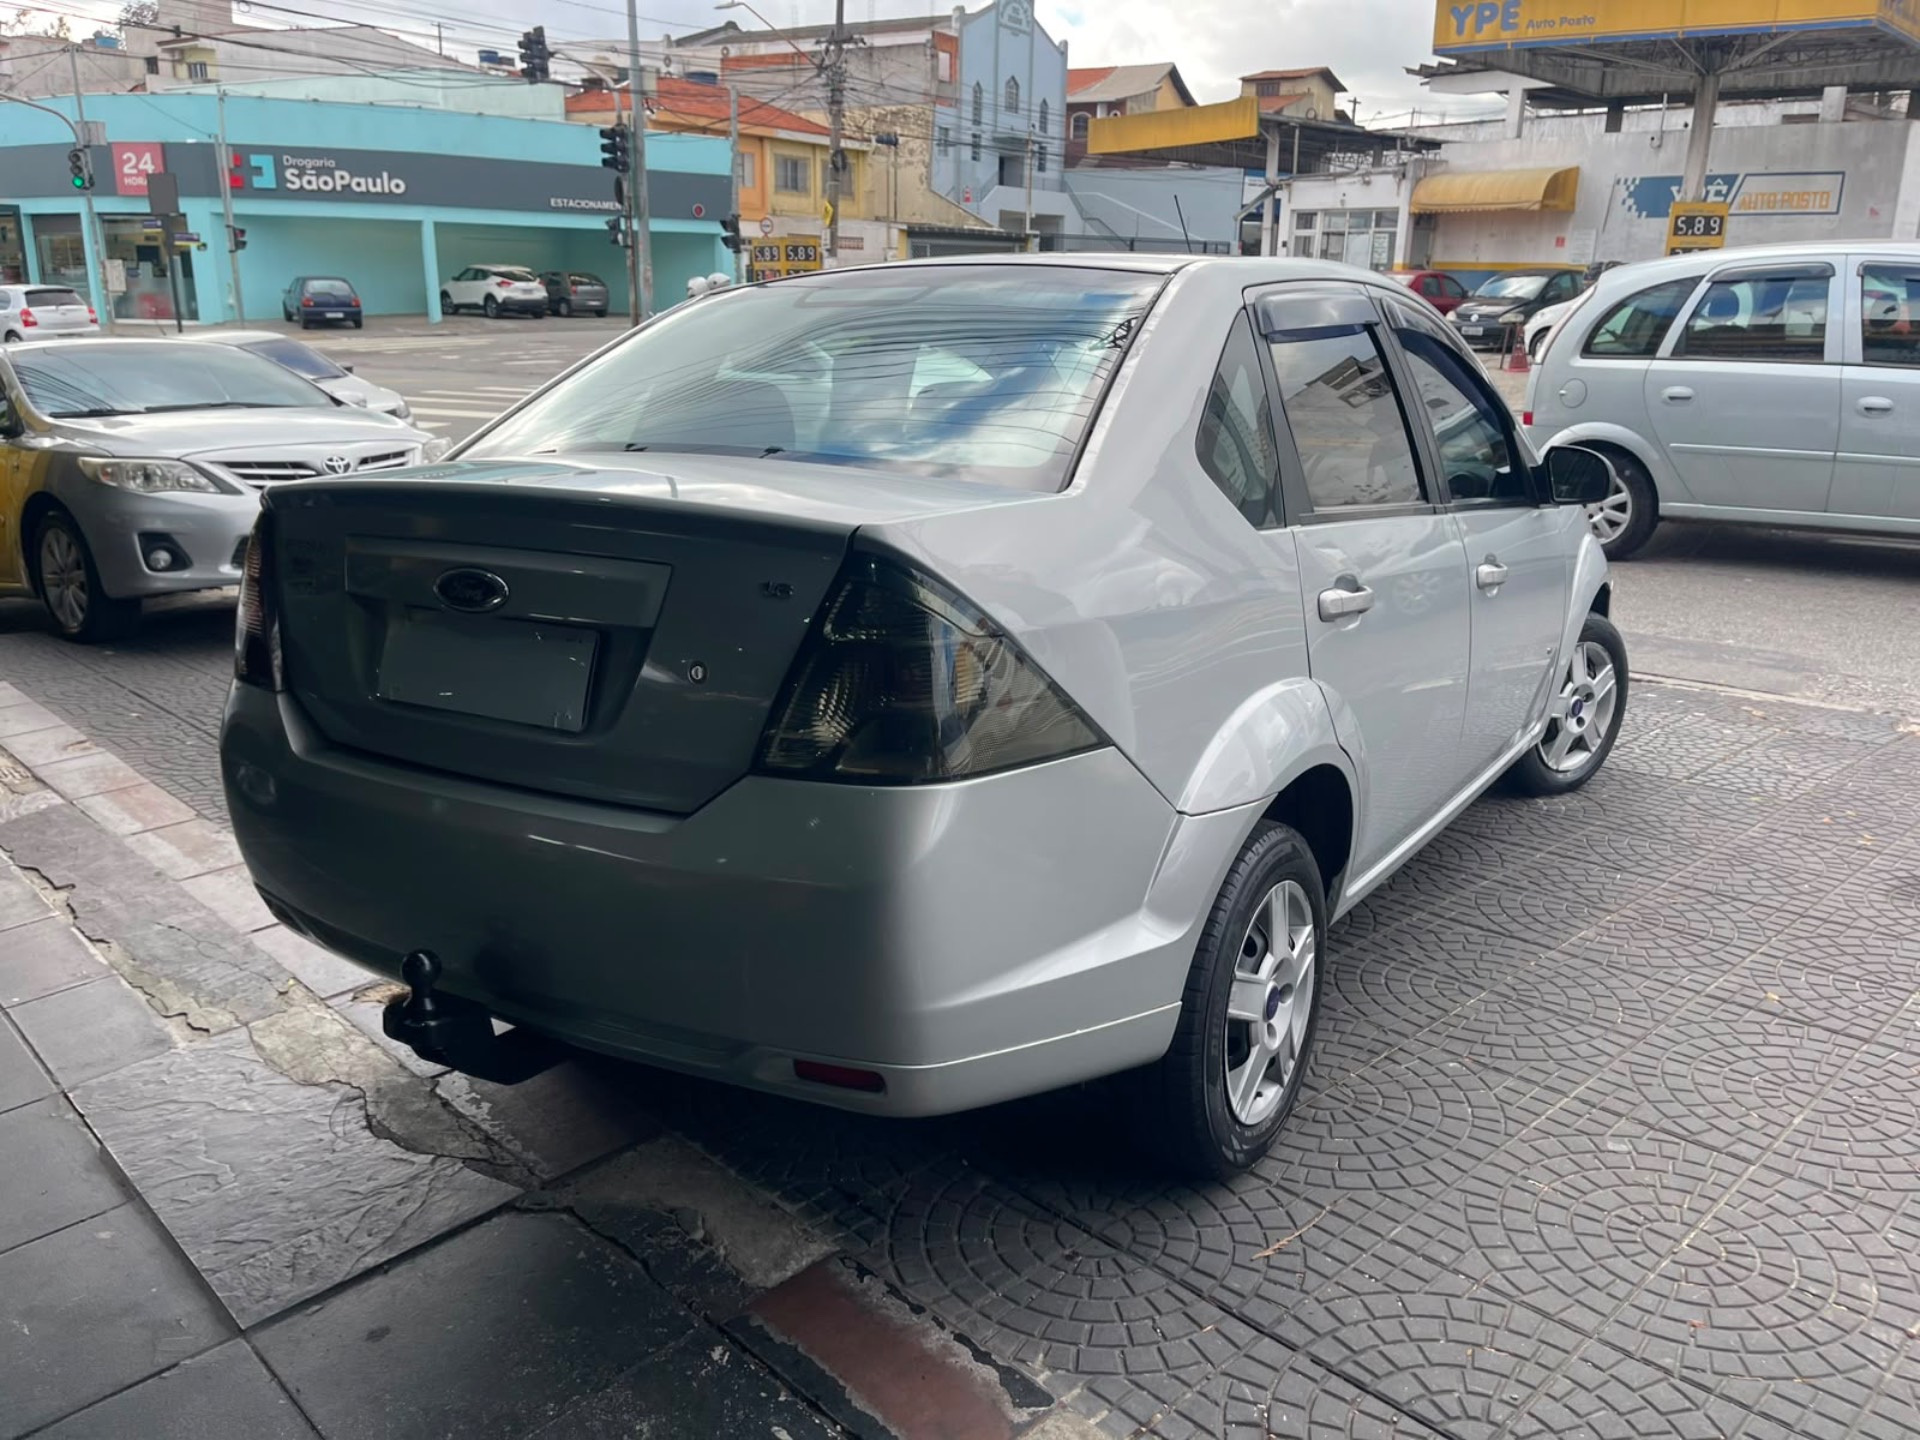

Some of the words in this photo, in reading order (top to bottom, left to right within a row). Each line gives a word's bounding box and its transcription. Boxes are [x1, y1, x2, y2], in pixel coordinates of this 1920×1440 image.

[1526, 18, 1556, 30] Auto
[1559, 14, 1596, 27] Posto
[122, 151, 156, 174] 24
[282, 155, 336, 168] Drogaria
[549, 197, 623, 211] ESTACIONAMEN
[1739, 191, 1778, 211] AUTO
[1781, 191, 1831, 210] POSTO
[1676, 216, 1721, 235] 5,89
